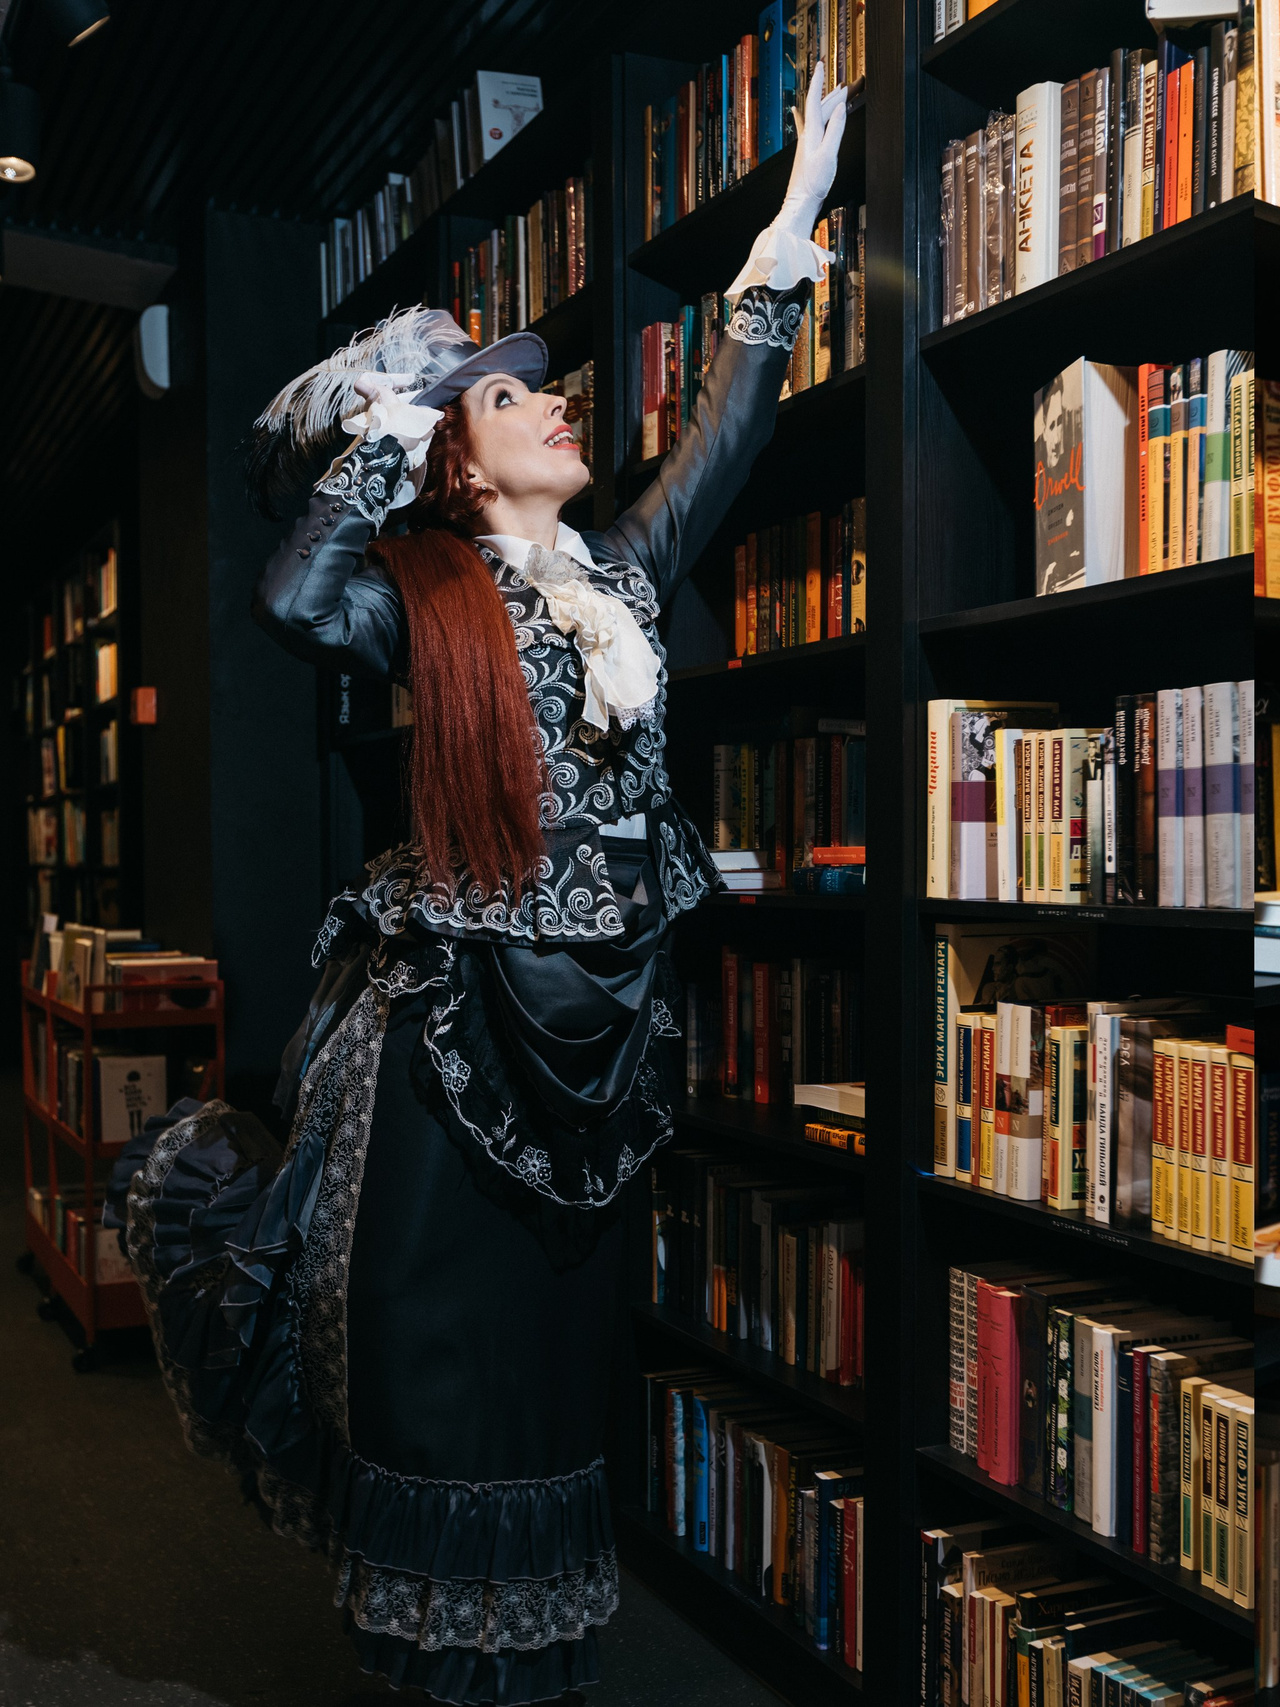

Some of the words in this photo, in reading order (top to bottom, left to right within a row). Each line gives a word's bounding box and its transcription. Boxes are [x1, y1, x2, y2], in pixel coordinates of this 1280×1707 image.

[1143, 79, 1155, 123] ГЕССЕ
[1144, 124, 1155, 166] ГЕРМАН
[1018, 139, 1034, 253] АНКЕТА
[1234, 390, 1242, 436] ОРУЭЛЛ
[1034, 441, 1086, 511] Orwell
[1119, 710, 1127, 765] фехтования
[1141, 708, 1151, 731] люди
[929, 730, 939, 794] Чикита
[1141, 732, 1151, 765] Добрые
[1053, 785, 1060, 797] де
[936, 941, 946, 993] РЕМАРК
[936, 996, 946, 1041] МАРИЯ
[937, 1044, 946, 1078] ЭРИХ
[982, 1032, 990, 1071] РЕМАРК
[1050, 1044, 1058, 1098] ХЕМИНГУЭЙ
[1121, 1035, 1131, 1066] УЭСТ
[1155, 1057, 1163, 1100] РЕМАРК
[1165, 1061, 1173, 1104] РЕМАРК
[1180, 1064, 1188, 1107] РЕМАРК
[1194, 1065, 1203, 1110] РЕМАРК
[1214, 1068, 1223, 1114] РЕМАРК
[1236, 1072, 1246, 1118] РЕМАРК
[1099, 1102, 1107, 1135] БАНДА
[1238, 1120, 1246, 1149] МАРИЯ
[1099, 1137, 1107, 1187] ГИНЬОЛЕЙ
[1203, 1419, 1211, 1461] ФОЛКНЕР
[1236, 1425, 1247, 1471] ФРИШ
[1236, 1474, 1247, 1512] МАКС
